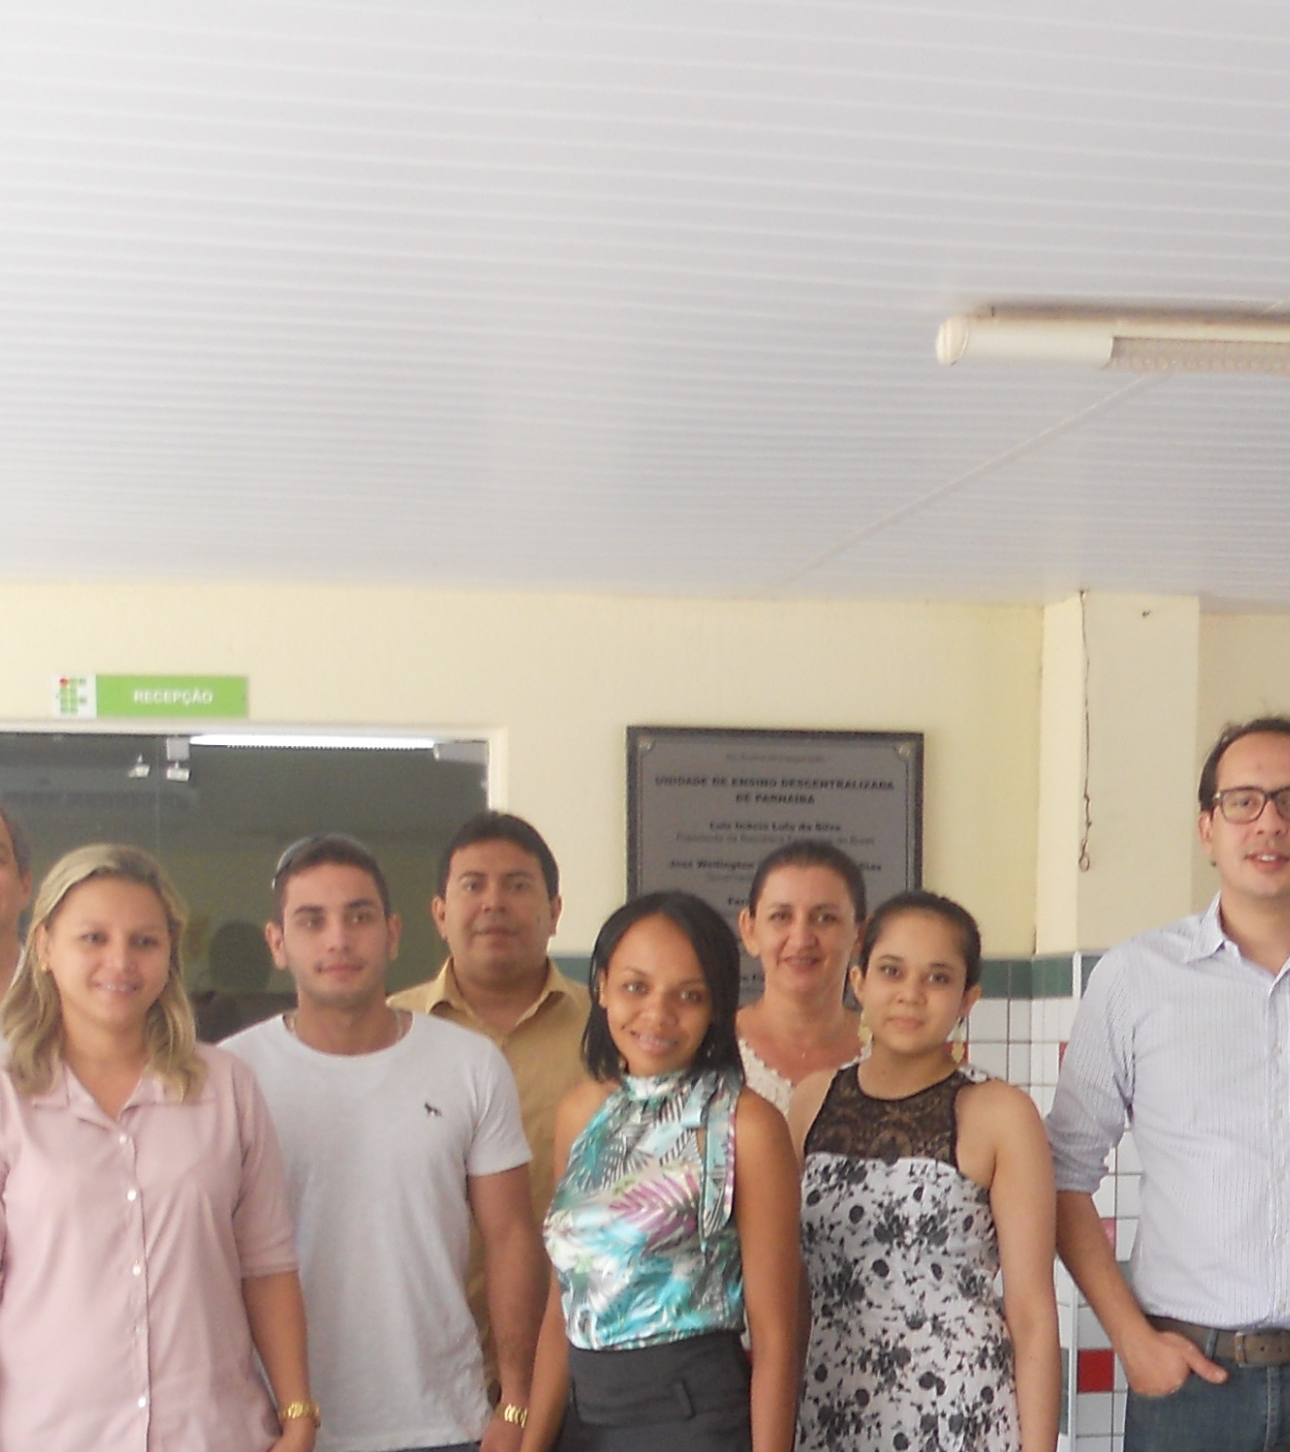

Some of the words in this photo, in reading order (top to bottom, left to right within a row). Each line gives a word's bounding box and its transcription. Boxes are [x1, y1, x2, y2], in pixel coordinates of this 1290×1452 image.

[133, 688, 213, 706] RECEPÇÃO
[712, 777, 727, 787] DE
[731, 777, 777, 789] ENSINO
